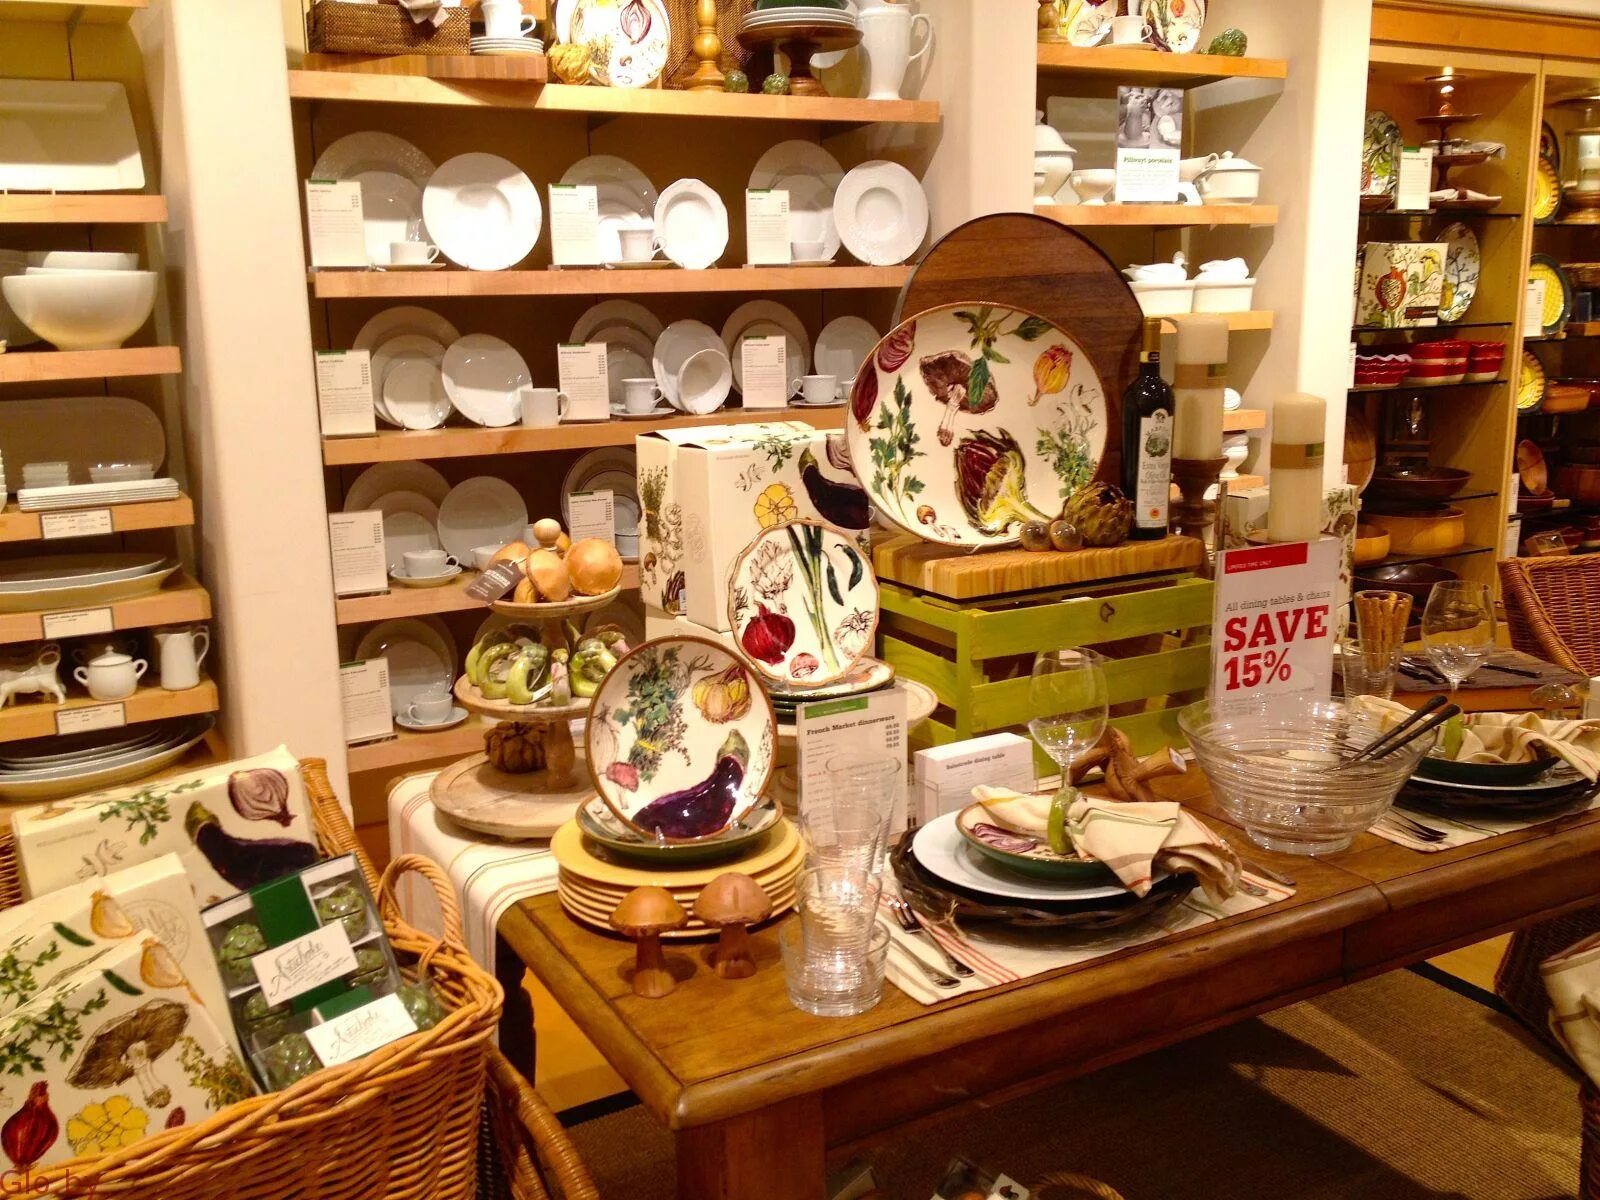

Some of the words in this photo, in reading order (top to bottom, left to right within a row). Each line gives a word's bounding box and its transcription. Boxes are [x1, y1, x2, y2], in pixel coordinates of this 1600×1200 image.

[1247, 560, 1258, 568] TIME
[1259, 559, 1272, 567] ONLY
[1225, 602, 1238, 612] All
[1240, 598, 1267, 610] dining
[1269, 594, 1295, 606] tables
[1296, 592, 1304, 602] &
[1306, 590, 1332, 599] chairs
[1223, 604, 1329, 652] SAVE
[1223, 648, 1292, 691] 15%
[806, 726, 831, 736] French
[832, 721, 856, 731] Market
[857, 714, 895, 727] dinnerware
